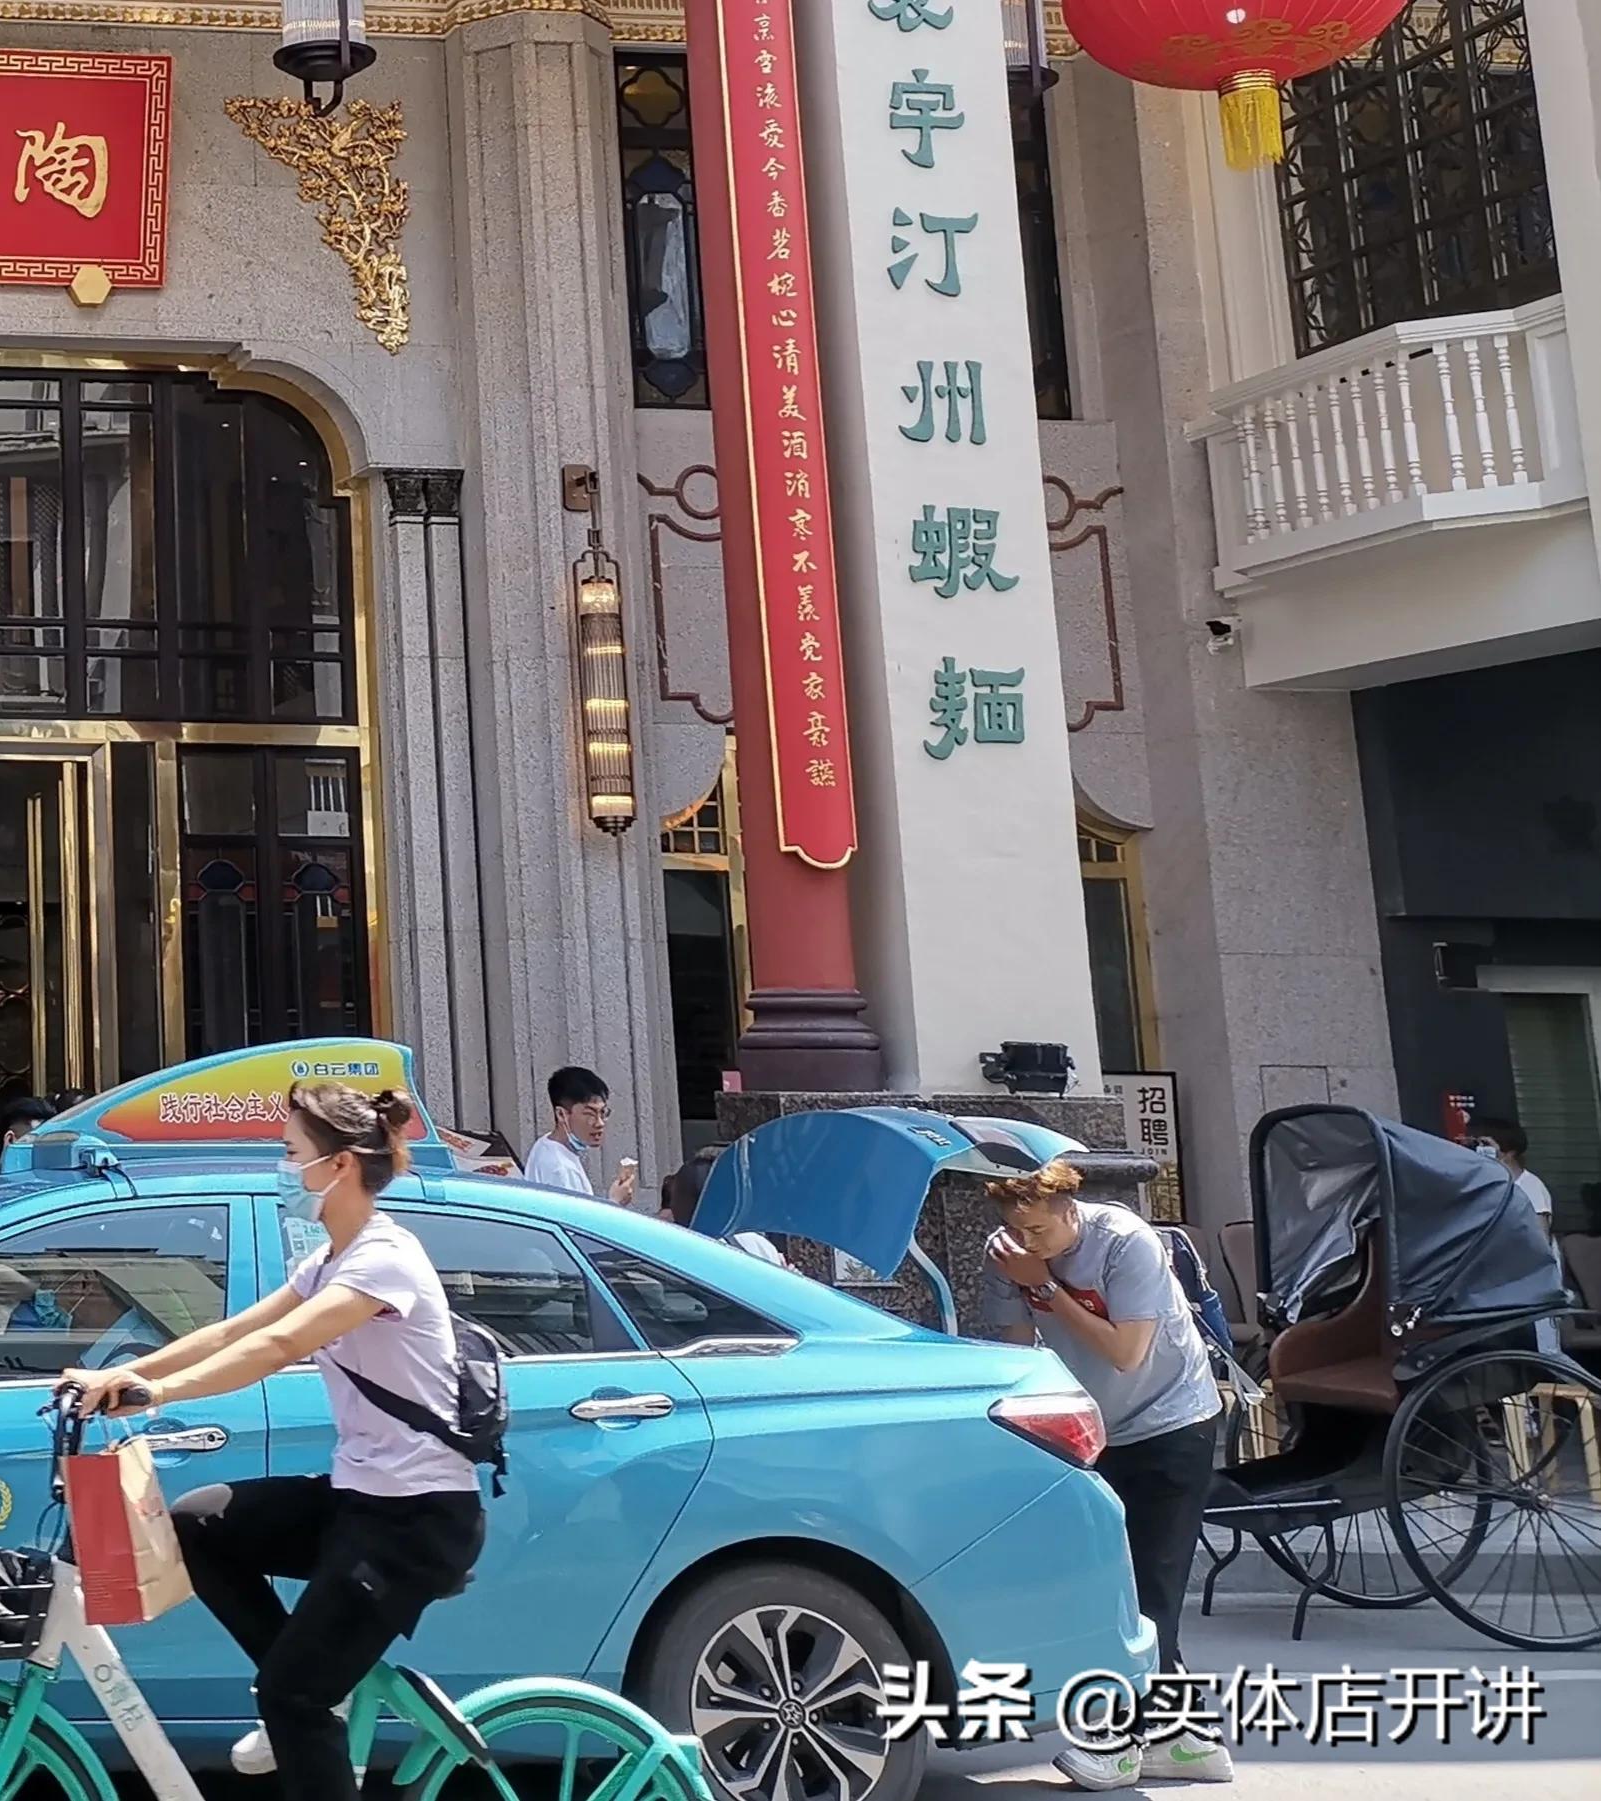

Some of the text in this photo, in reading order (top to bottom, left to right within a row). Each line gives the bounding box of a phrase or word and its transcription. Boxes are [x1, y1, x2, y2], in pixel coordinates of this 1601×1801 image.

[314, 1062, 380, 1076] 白云集团
[159, 1092, 290, 1123] 践行社会主义
[1137, 1086, 1169, 1147] 招聘
